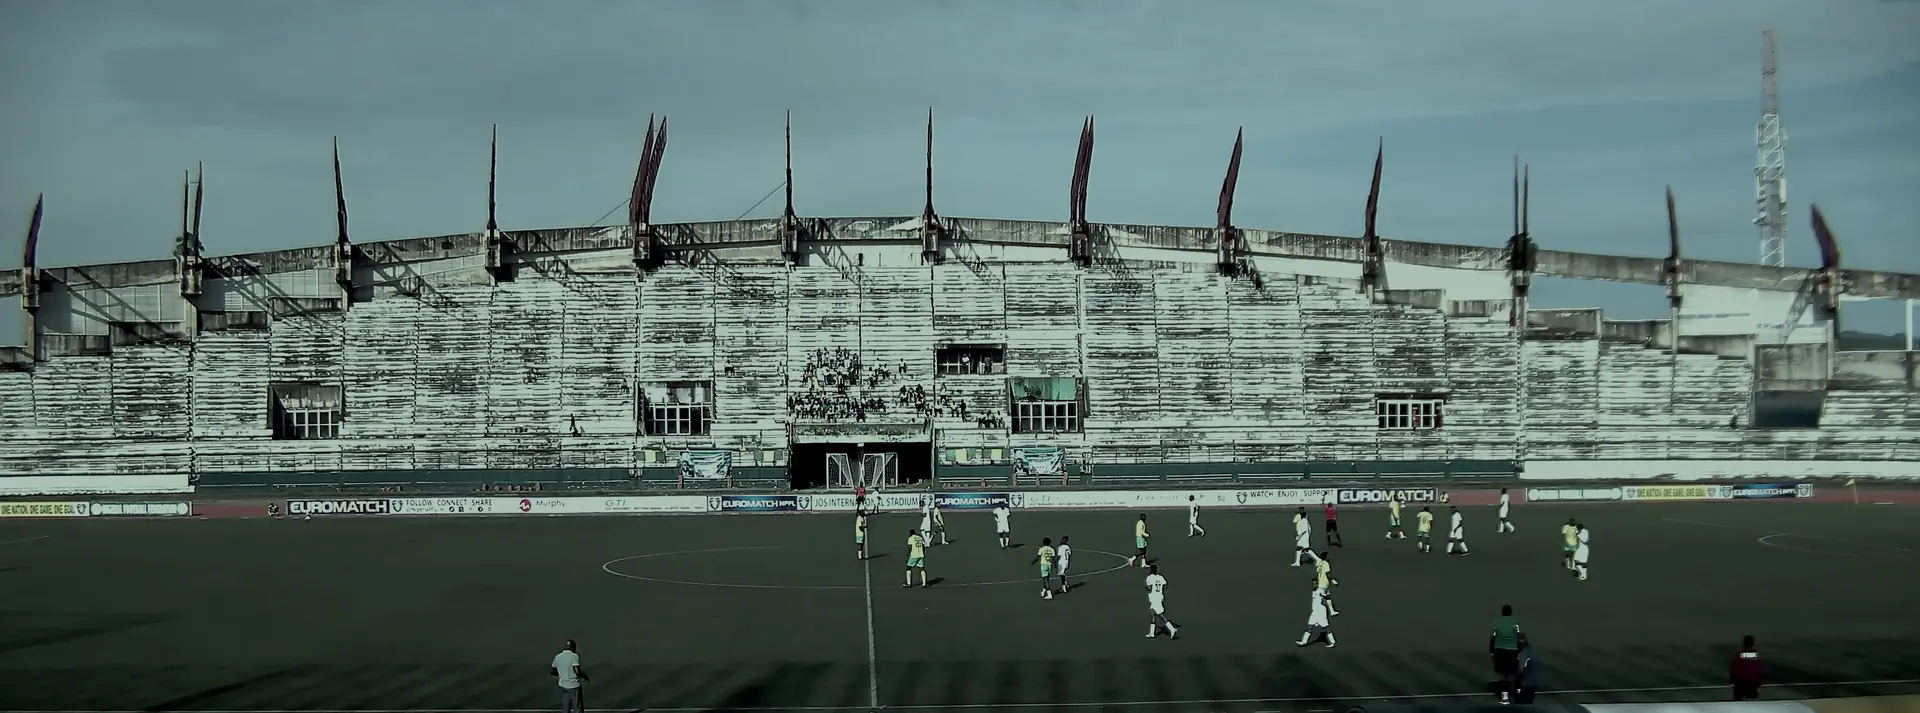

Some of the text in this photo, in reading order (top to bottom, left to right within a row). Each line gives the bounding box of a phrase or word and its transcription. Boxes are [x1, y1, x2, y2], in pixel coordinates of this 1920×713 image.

[1250, 490, 1273, 498] WATCH
[1340, 489, 1434, 502] EUROMATCH
[290, 501, 387, 513] EUROMATCH
[722, 500, 778, 508] EUROMATCH
[815, 498, 828, 507] JOS
[887, 497, 918, 506] STADIUM
